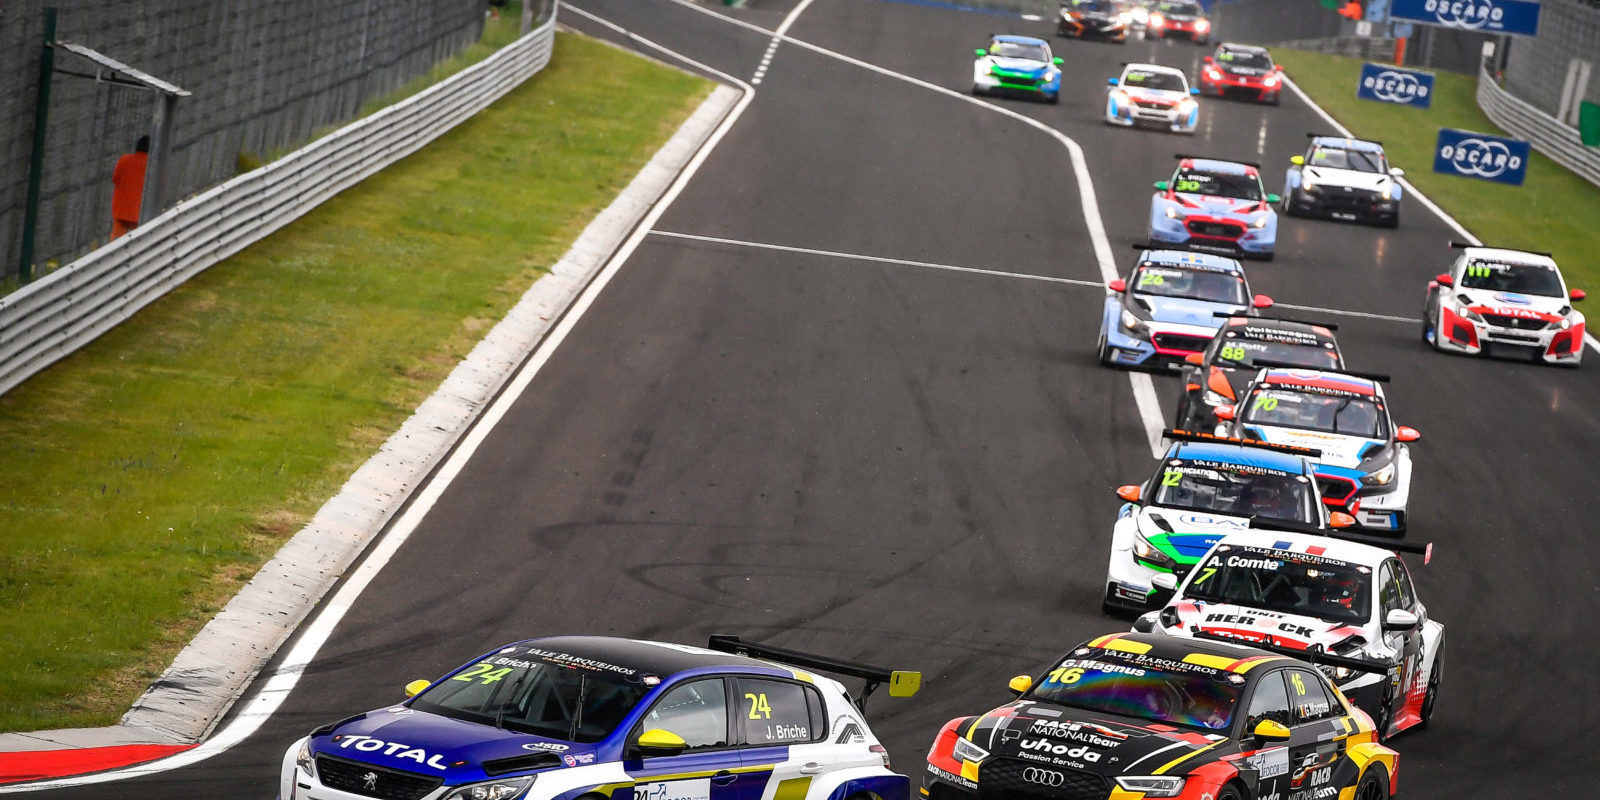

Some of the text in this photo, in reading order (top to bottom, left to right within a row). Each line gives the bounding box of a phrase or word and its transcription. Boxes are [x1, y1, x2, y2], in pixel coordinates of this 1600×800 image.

[1424, 0, 1504, 21] OSCARO
[1363, 76, 1429, 98] OSCARO
[1440, 144, 1522, 170] OSCARO
[1176, 180, 1200, 192] 30
[1141, 274, 1164, 286] 26
[1468, 265, 1491, 278] 111
[1493, 306, 1541, 319] TOTAL
[1245, 327, 1317, 340] Volkswagen
[1221, 347, 1245, 361] 88
[1280, 382, 1303, 391] VALE
[1253, 397, 1279, 412] 70
[1193, 459, 1287, 477] VALE BARQUEIROS
[1161, 471, 1184, 487] 12
[1207, 556, 1279, 570] A. Comte
[1243, 545, 1347, 566] VALE BARQUEIROS
[1194, 568, 1217, 585] 7
[1246, 609, 1287, 619] UNIT
[526, 648, 636, 675] VALE BARQUEIROS
[1061, 659, 1146, 676] G.Magnus
[1104, 649, 1133, 659] VALE
[1139, 654, 1218, 675] BARQUEIROS
[452, 663, 514, 685] 24
[1048, 667, 1085, 684] 16
[1291, 672, 1306, 696] 16
[744, 692, 772, 720] 24
[766, 724, 807, 740] J. Briche
[1034, 719, 1081, 731] RACB
[340, 735, 447, 770] TOTAL
[1020, 738, 1101, 762] uhoda
[1018, 751, 1085, 769] Passion Service
[1310, 766, 1332, 787] RACB
